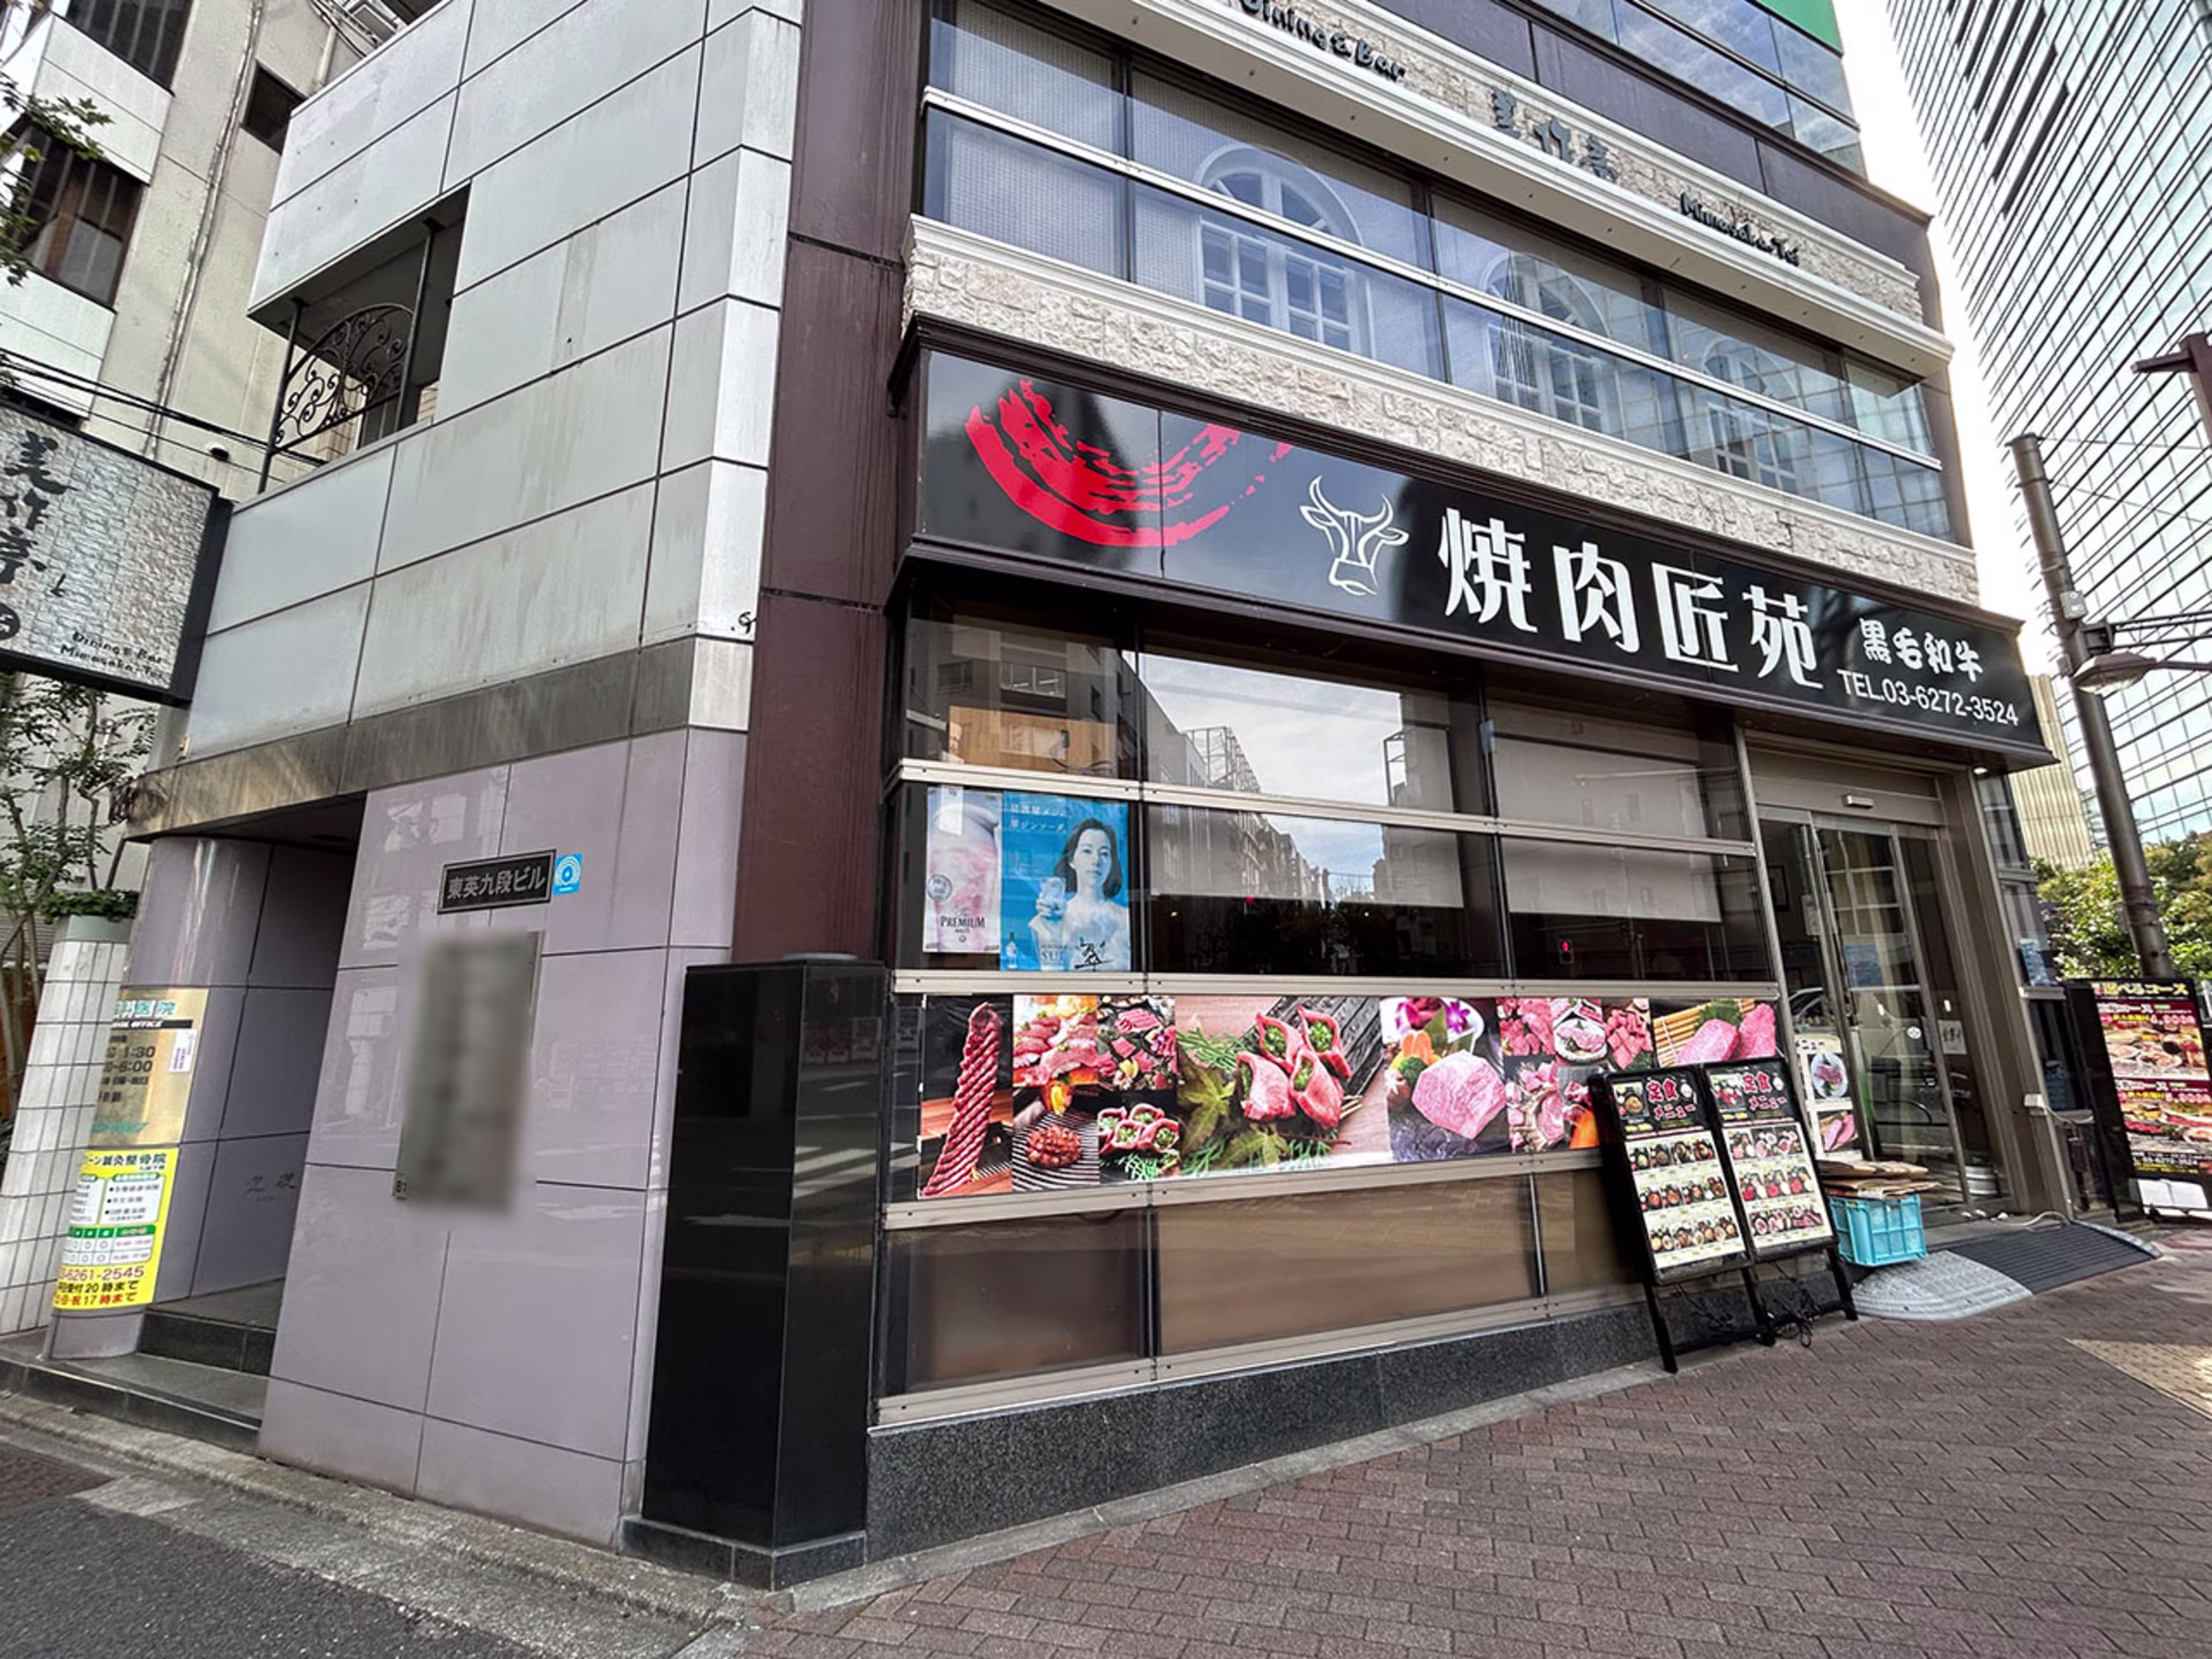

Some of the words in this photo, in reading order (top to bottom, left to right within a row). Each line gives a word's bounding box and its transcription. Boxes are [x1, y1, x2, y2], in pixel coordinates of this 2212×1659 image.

[1354, 39, 1406, 82] Bar
[1438, 507, 1824, 689] 焼肉匠苑
[1859, 618, 1983, 682] 黒毛和牛
[446, 866, 547, 899] 東英九段ビル
[940, 915, 986, 929] PREMIUM
[1646, 1079, 1677, 1102] 定食
[1741, 1071, 1771, 1093] 定食
